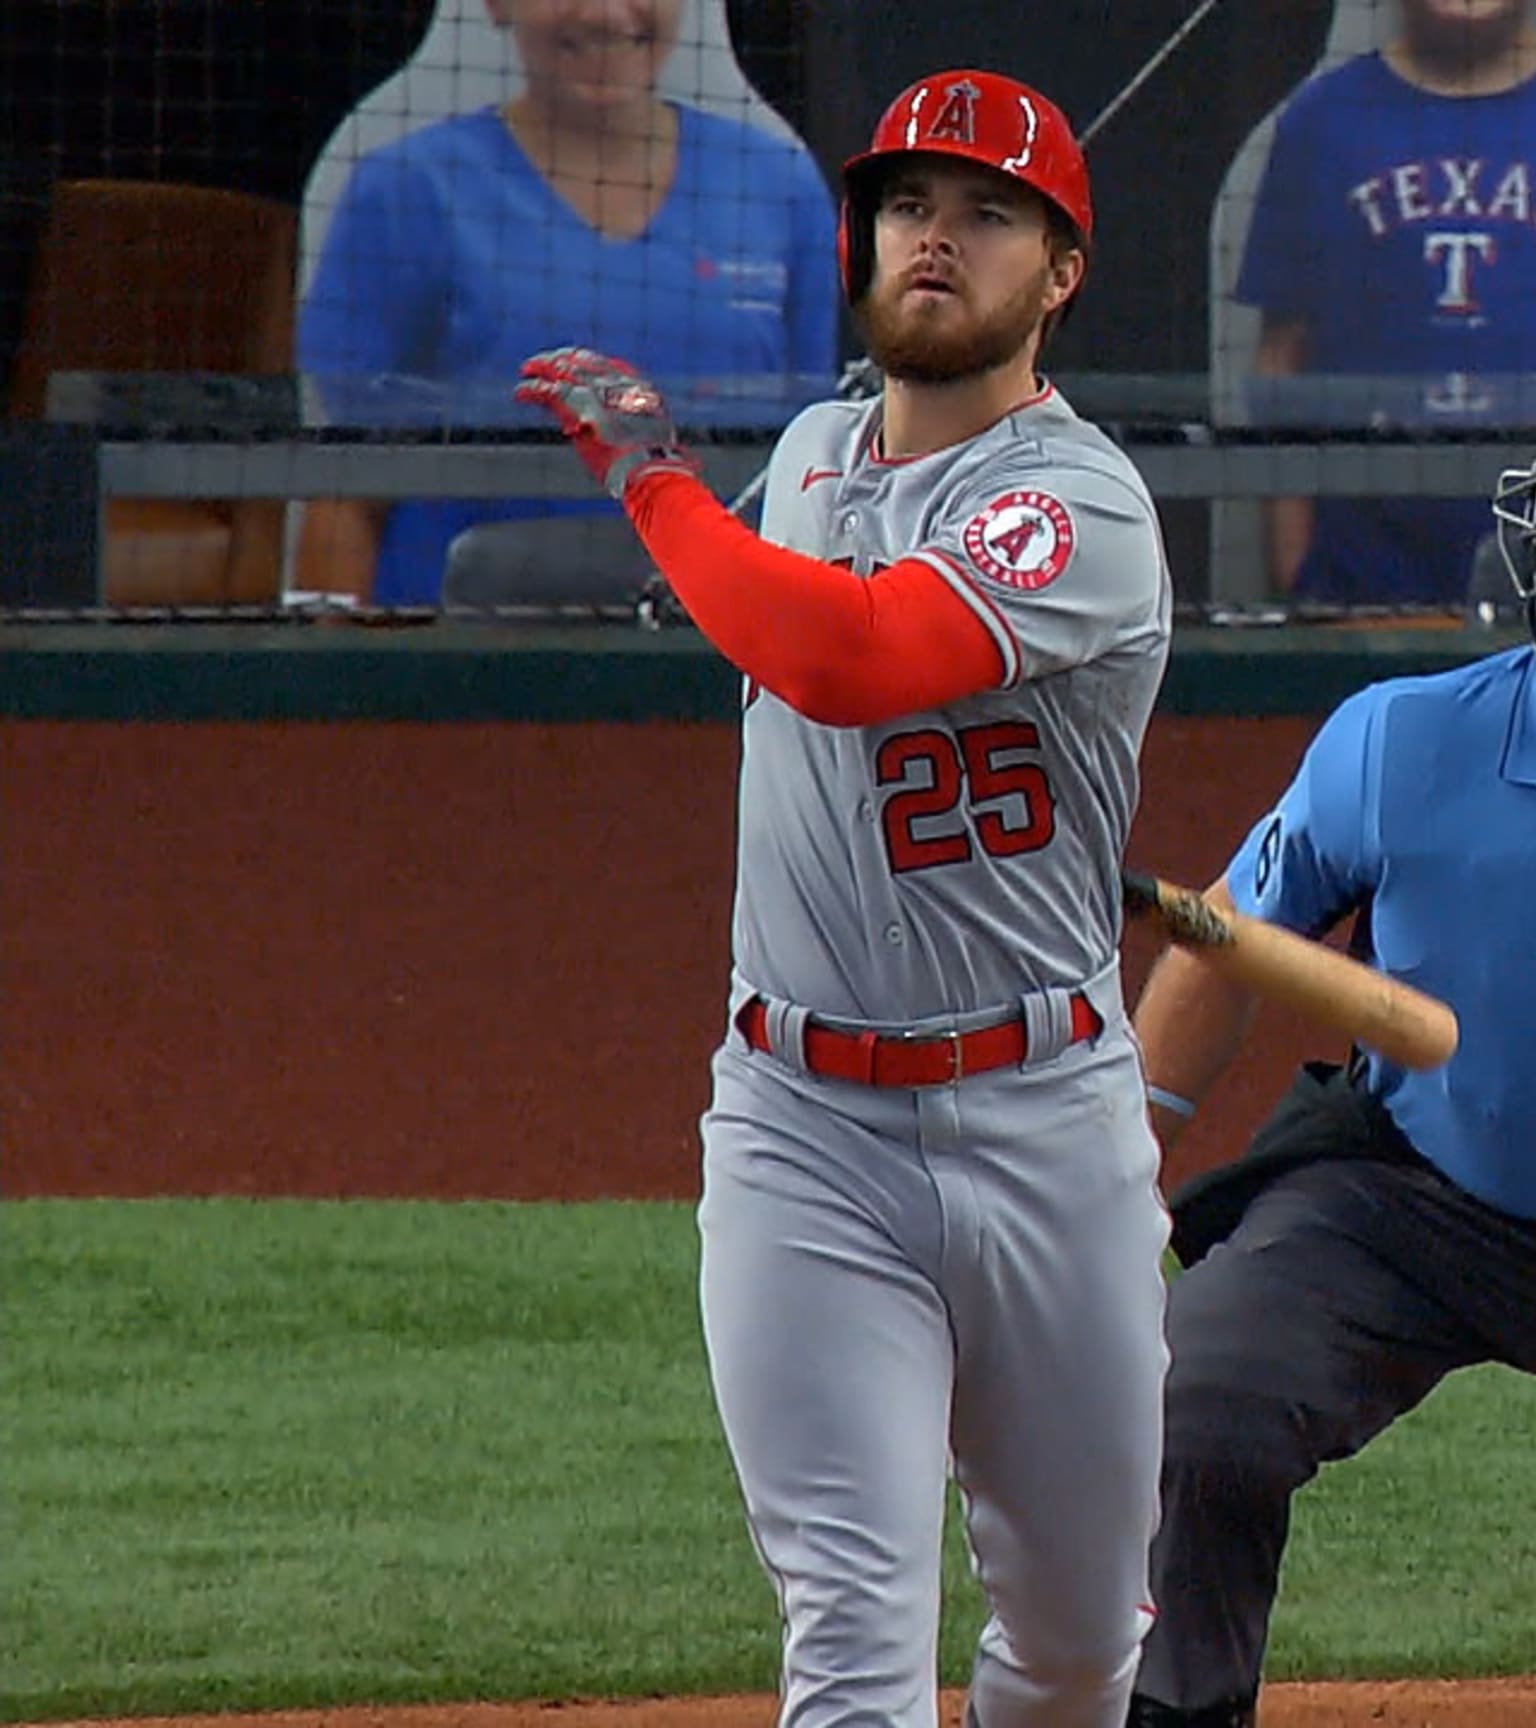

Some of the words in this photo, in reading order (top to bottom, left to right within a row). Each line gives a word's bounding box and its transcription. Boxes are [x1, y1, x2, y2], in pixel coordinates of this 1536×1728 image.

[926, 81, 982, 143] A
[1423, 231, 1498, 314] T
[988, 515, 1046, 567] A
[876, 719, 1057, 874] 25
